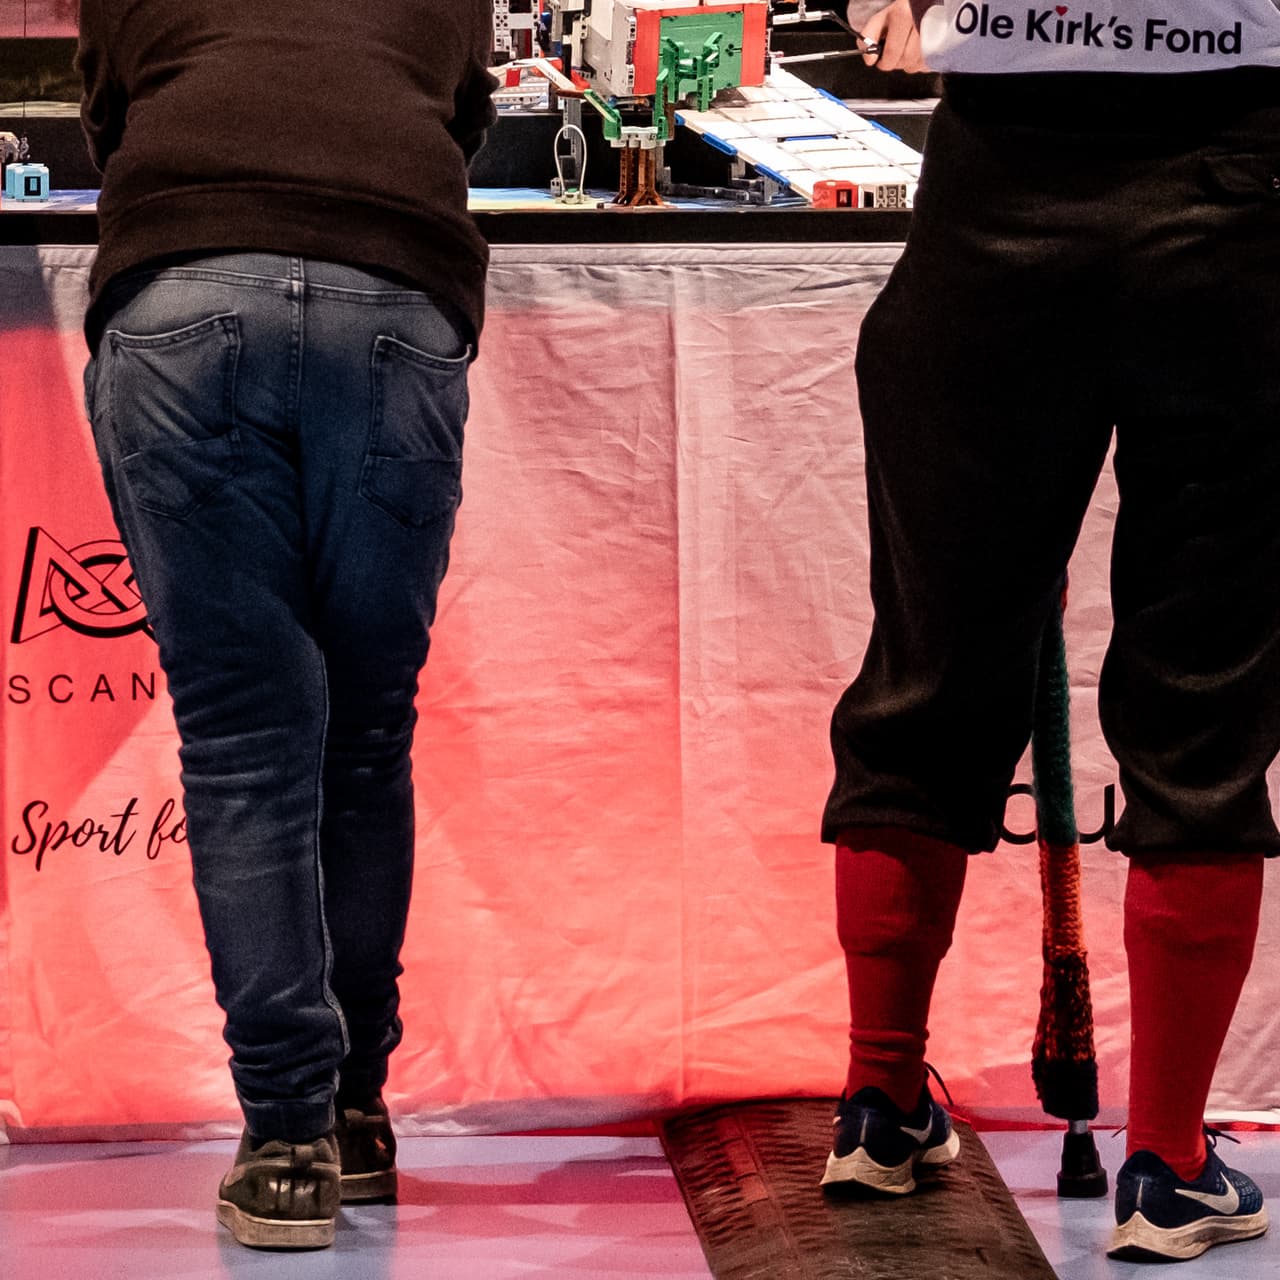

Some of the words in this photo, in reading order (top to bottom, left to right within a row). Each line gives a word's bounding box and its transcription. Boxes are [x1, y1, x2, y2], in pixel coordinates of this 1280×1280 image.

[955, 2, 1014, 40] Ole
[1145, 18, 1242, 55] Fond
[11, 797, 139, 872] Sport
